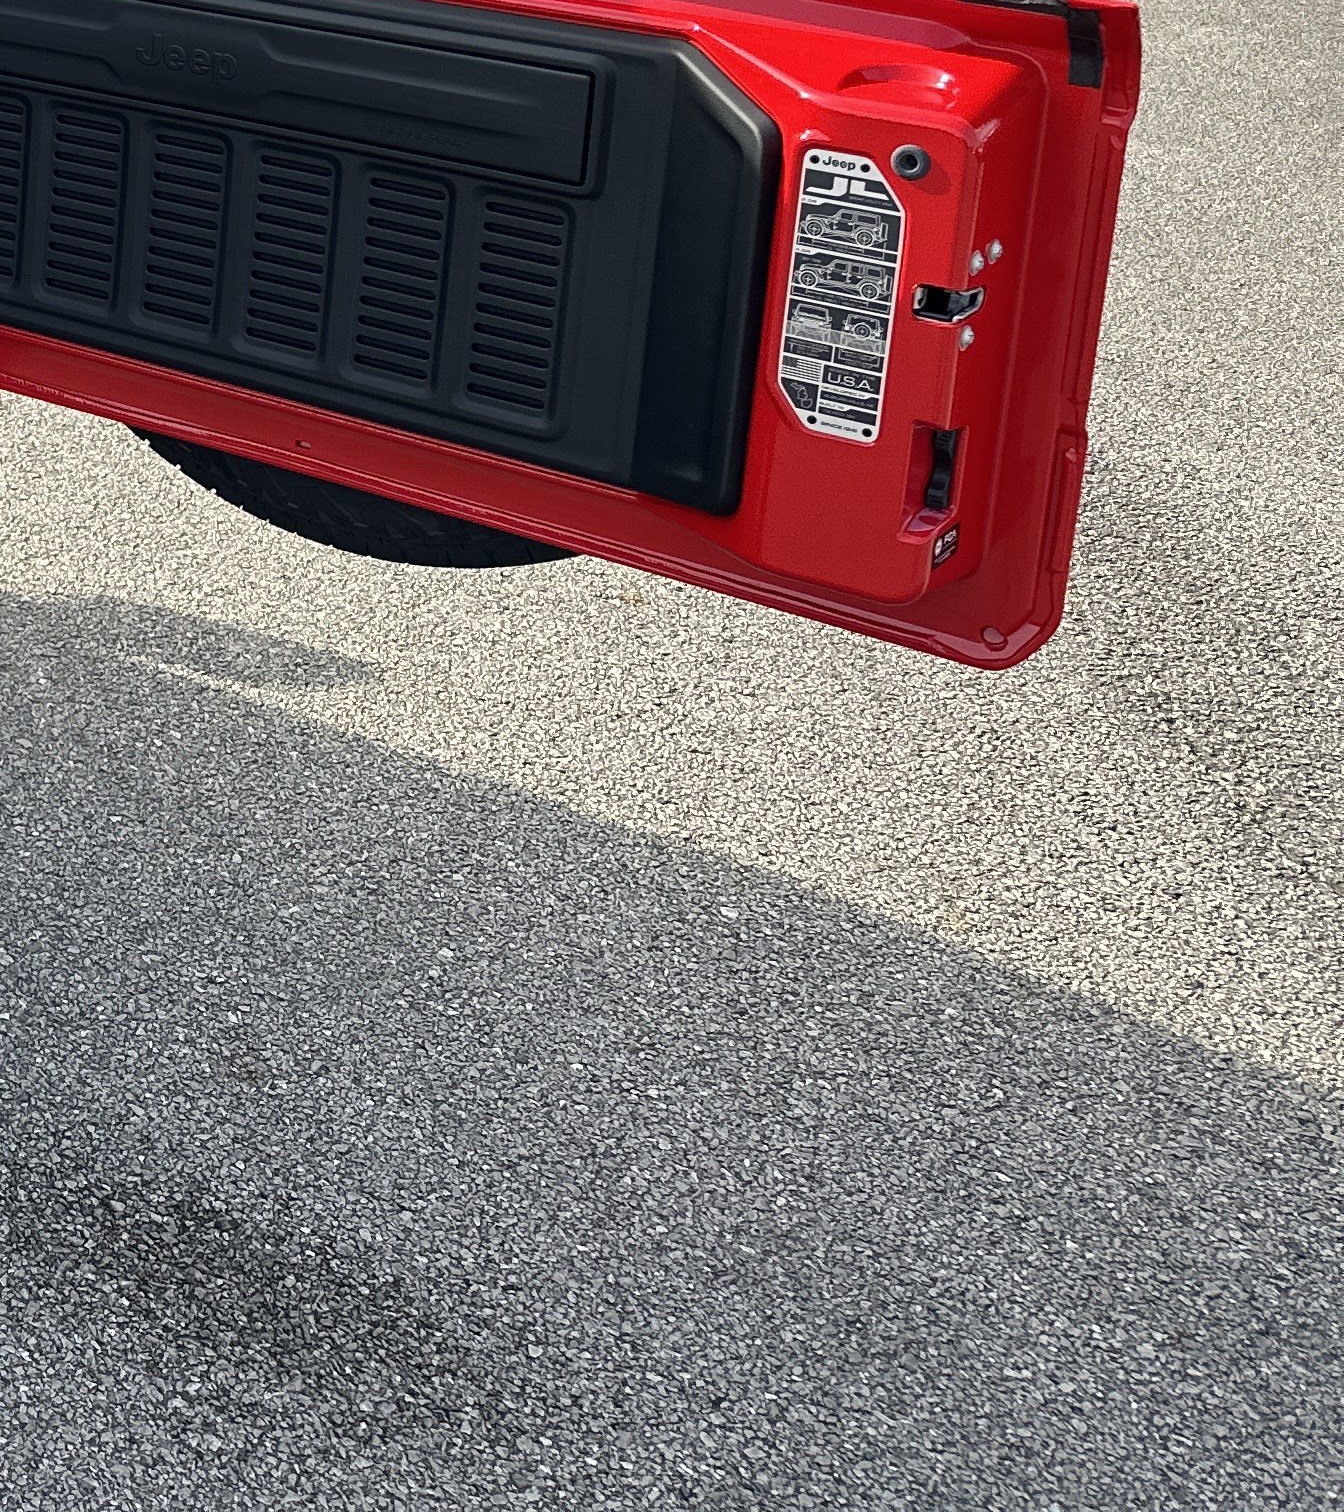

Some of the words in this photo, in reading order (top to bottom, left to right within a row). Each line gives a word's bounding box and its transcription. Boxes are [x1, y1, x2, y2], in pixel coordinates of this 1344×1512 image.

[135, 32, 238, 80] Jeep
[822, 155, 856, 172] Jeep
[805, 176, 890, 201] JL
